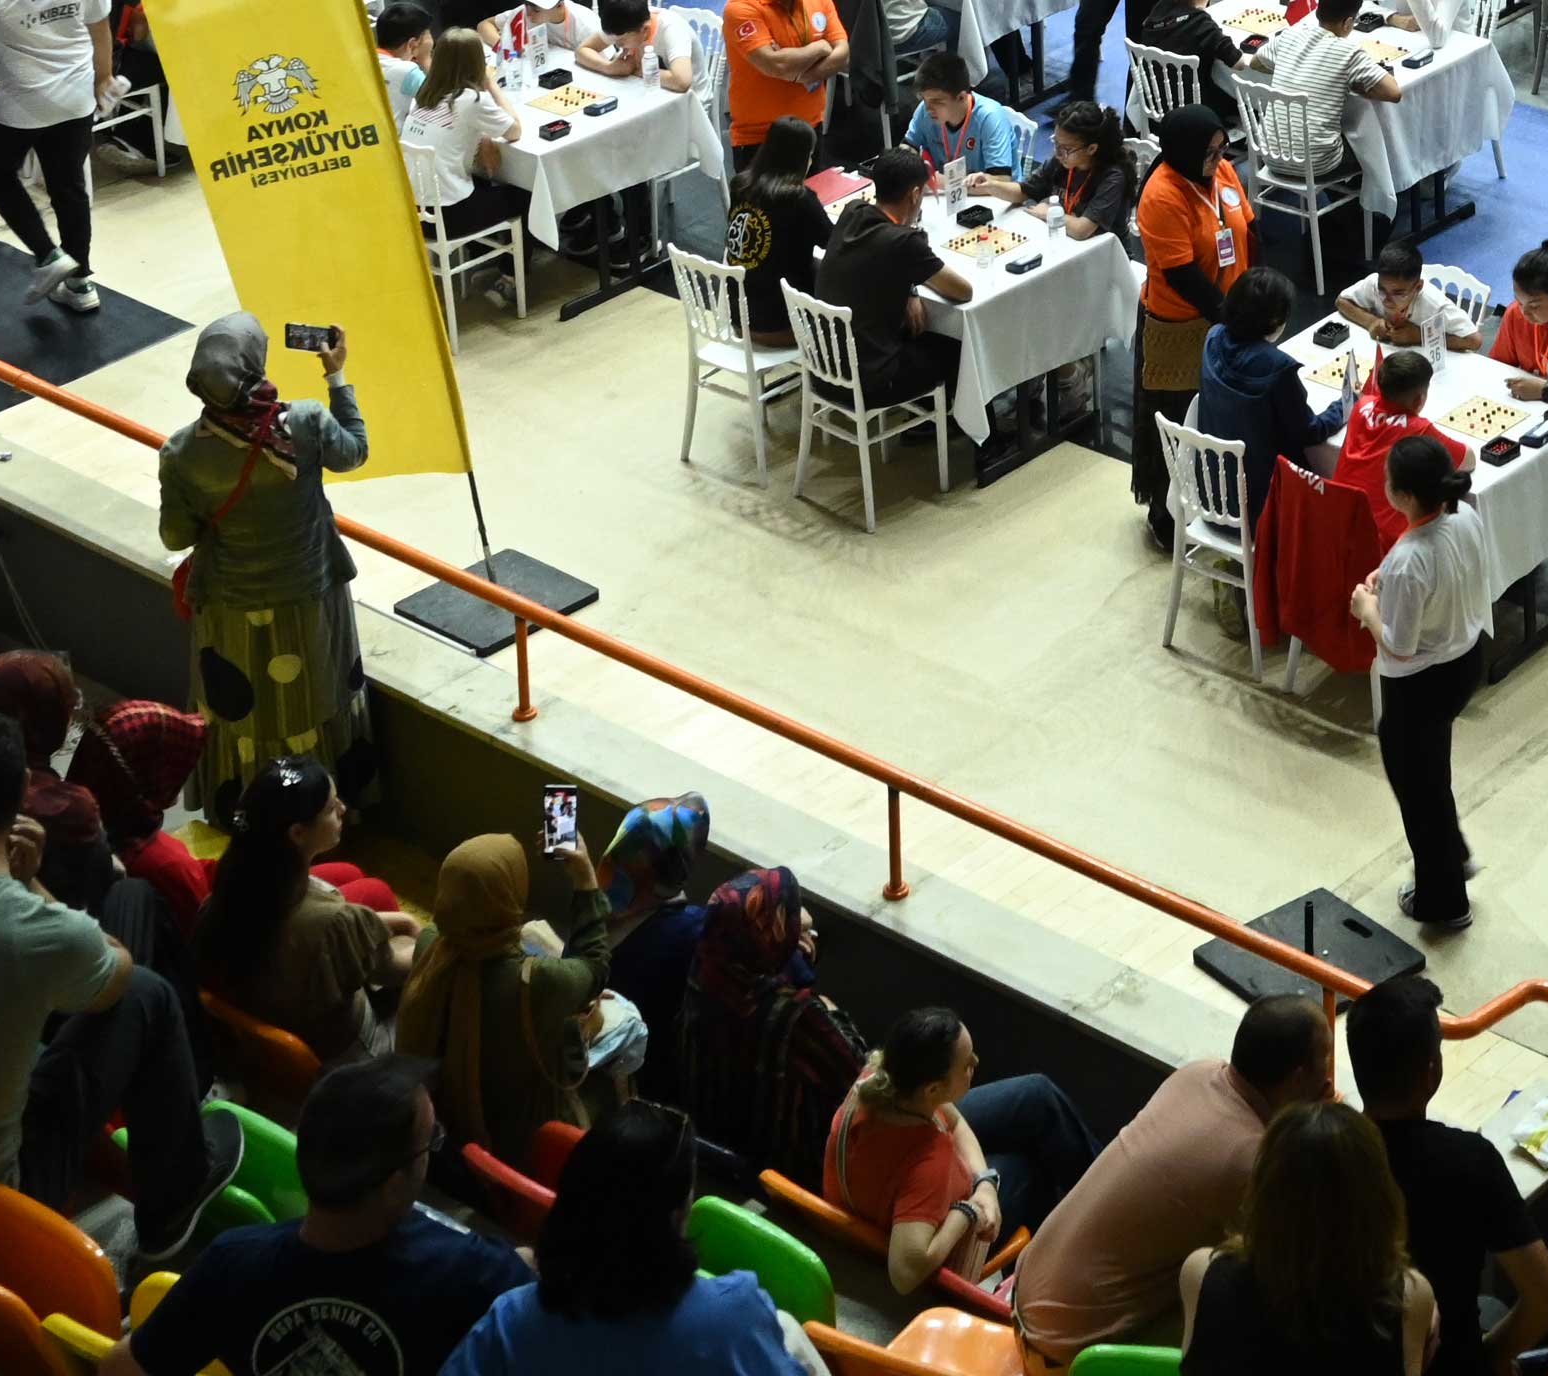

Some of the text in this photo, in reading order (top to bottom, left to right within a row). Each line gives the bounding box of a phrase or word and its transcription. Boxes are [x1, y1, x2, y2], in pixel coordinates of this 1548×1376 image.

[534, 52, 546, 68] 28
[951, 188, 963, 205] 32
[1429, 349, 1442, 365] 36
